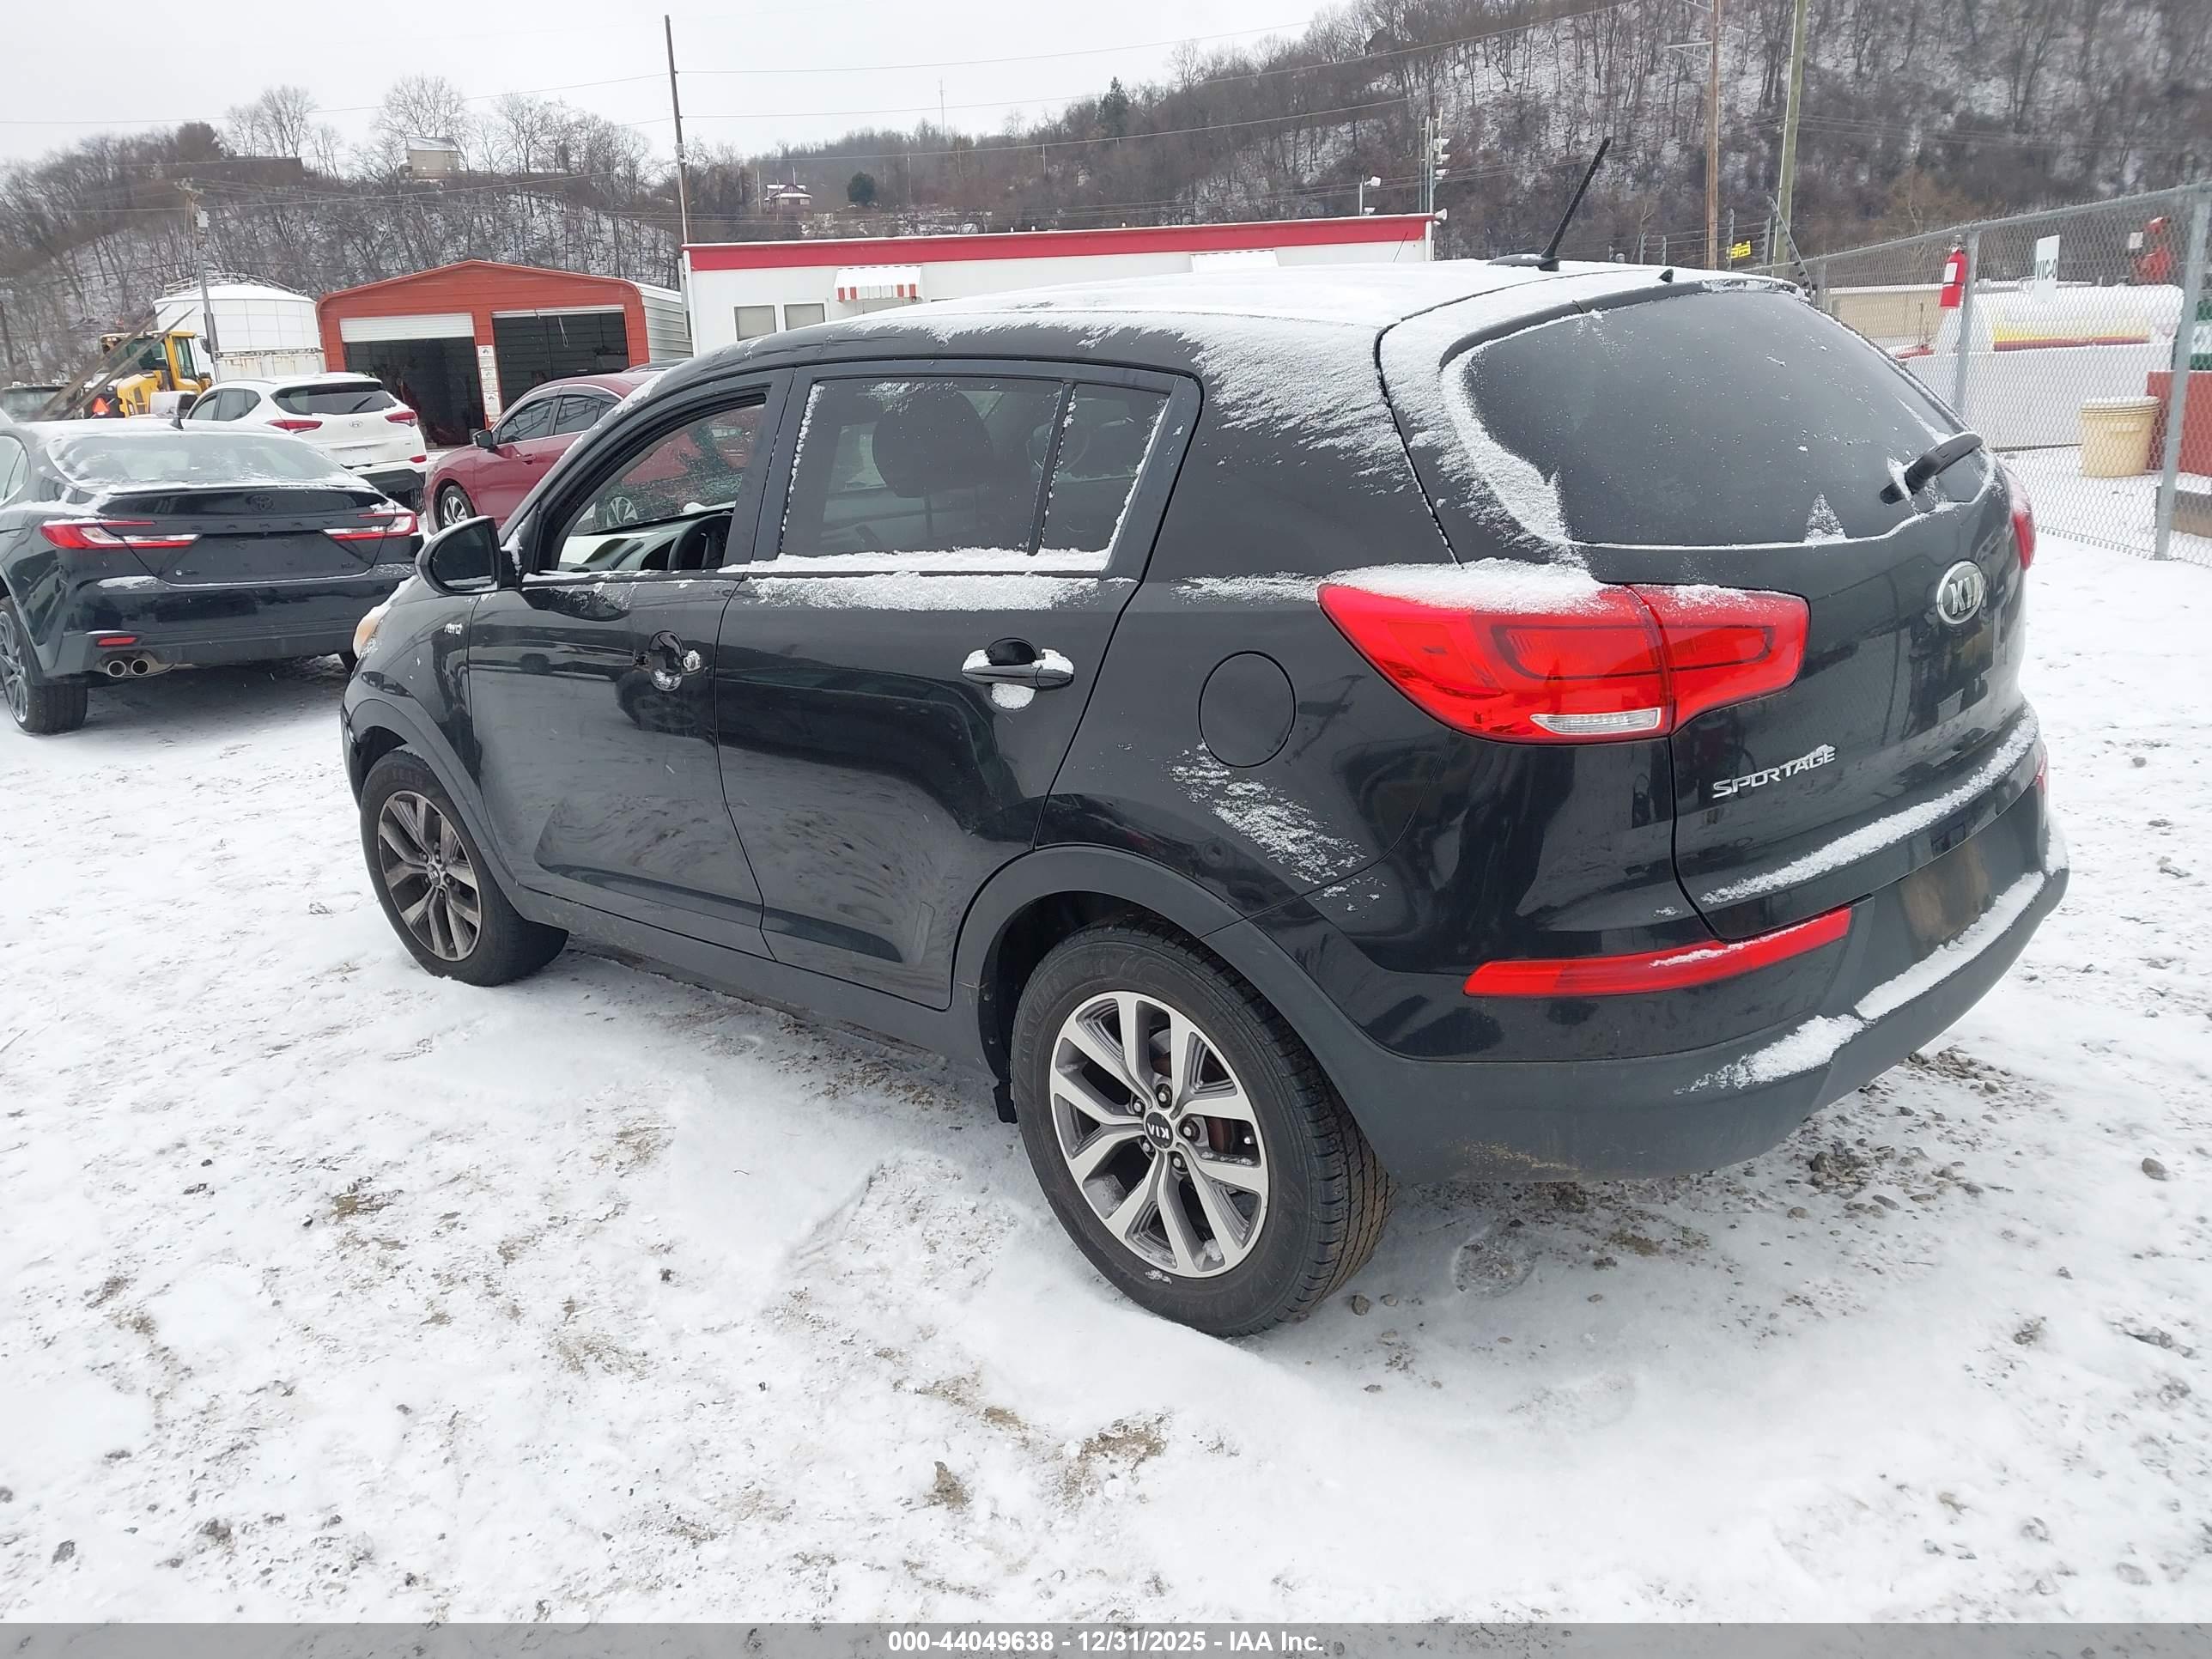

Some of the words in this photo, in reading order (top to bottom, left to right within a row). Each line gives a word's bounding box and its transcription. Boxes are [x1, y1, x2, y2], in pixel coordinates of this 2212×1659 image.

[1948, 573, 1982, 615] KIA
[1712, 744, 1836, 799] SPORTAGE
[1147, 1122, 1170, 1140] KIA
